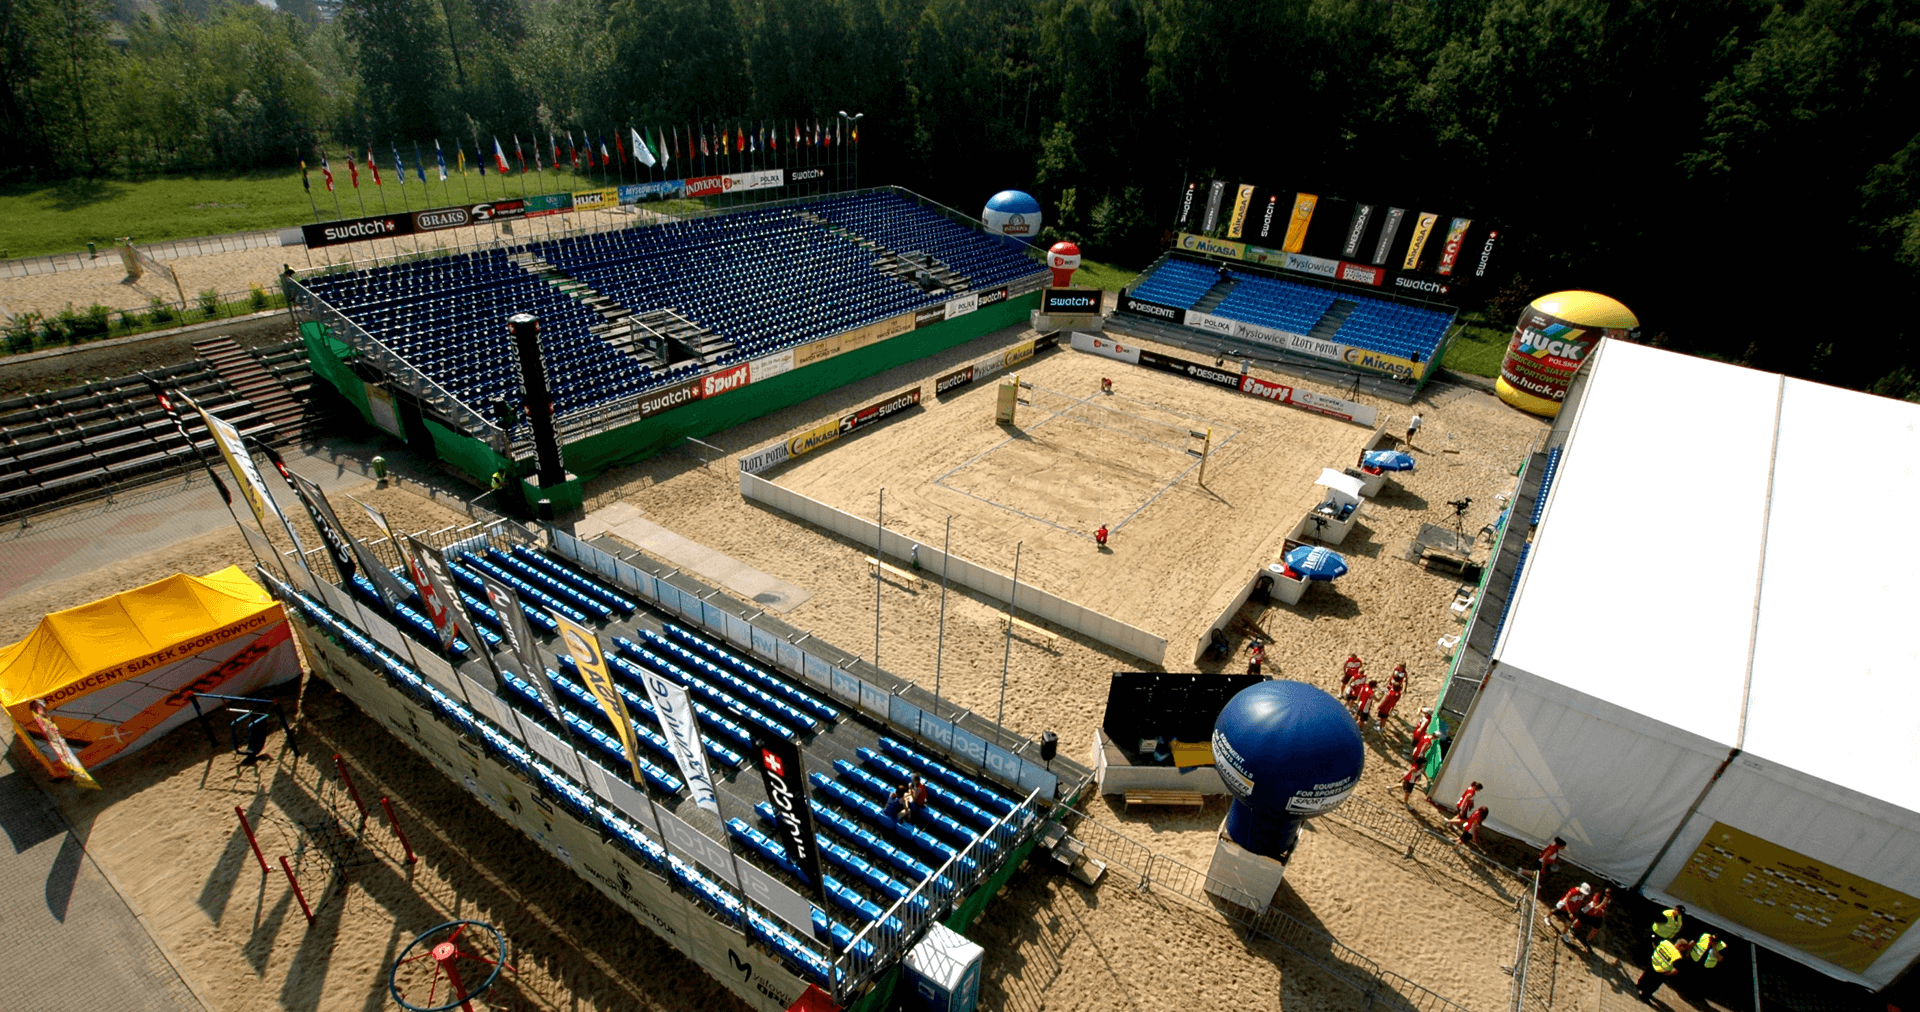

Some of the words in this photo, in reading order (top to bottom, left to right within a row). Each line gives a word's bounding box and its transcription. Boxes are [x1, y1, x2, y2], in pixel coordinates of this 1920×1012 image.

[792, 169, 820, 180] swatch
[686, 177, 722, 196] INDYKPOL
[574, 193, 602, 206] HUCK
[1180, 188, 1194, 223] swatch
[421, 211, 464, 227] BRAKS
[1232, 199, 1248, 236] MIKASA
[1260, 202, 1275, 238] swatch
[324, 219, 385, 241] swatch
[1196, 240, 1237, 257] MIKASA
[1475, 238, 1495, 277] swatch
[1395, 277, 1440, 294] swatch
[978, 290, 1002, 306] swatch
[1050, 297, 1089, 307] swatch
[1136, 303, 1175, 319] DESCENTE
[1520, 329, 1582, 360] HUCK
[510, 335, 527, 394] swatch
[1360, 357, 1414, 375] MIKASA
[1548, 357, 1580, 369] POLSKA
[937, 373, 967, 393] swatch
[1196, 368, 1238, 386] DESCENTE
[641, 388, 692, 414] swatch
[879, 394, 913, 417] swatch
[804, 428, 839, 449] MIKASA
[44, 667, 123, 706] RODUCENT
[127, 650, 177, 673] SIATEK
[178, 615, 267, 654] SPORTOWYCH
[1218, 761, 1250, 792] TRANSFER
[1233, 760, 1254, 779] HALLS
[1314, 787, 1343, 797] SPORTS
[1293, 798, 1325, 806] SPORT
[619, 889, 650, 917] WORLD
[651, 912, 677, 936] TOUR
[757, 983, 790, 1009] OPE
